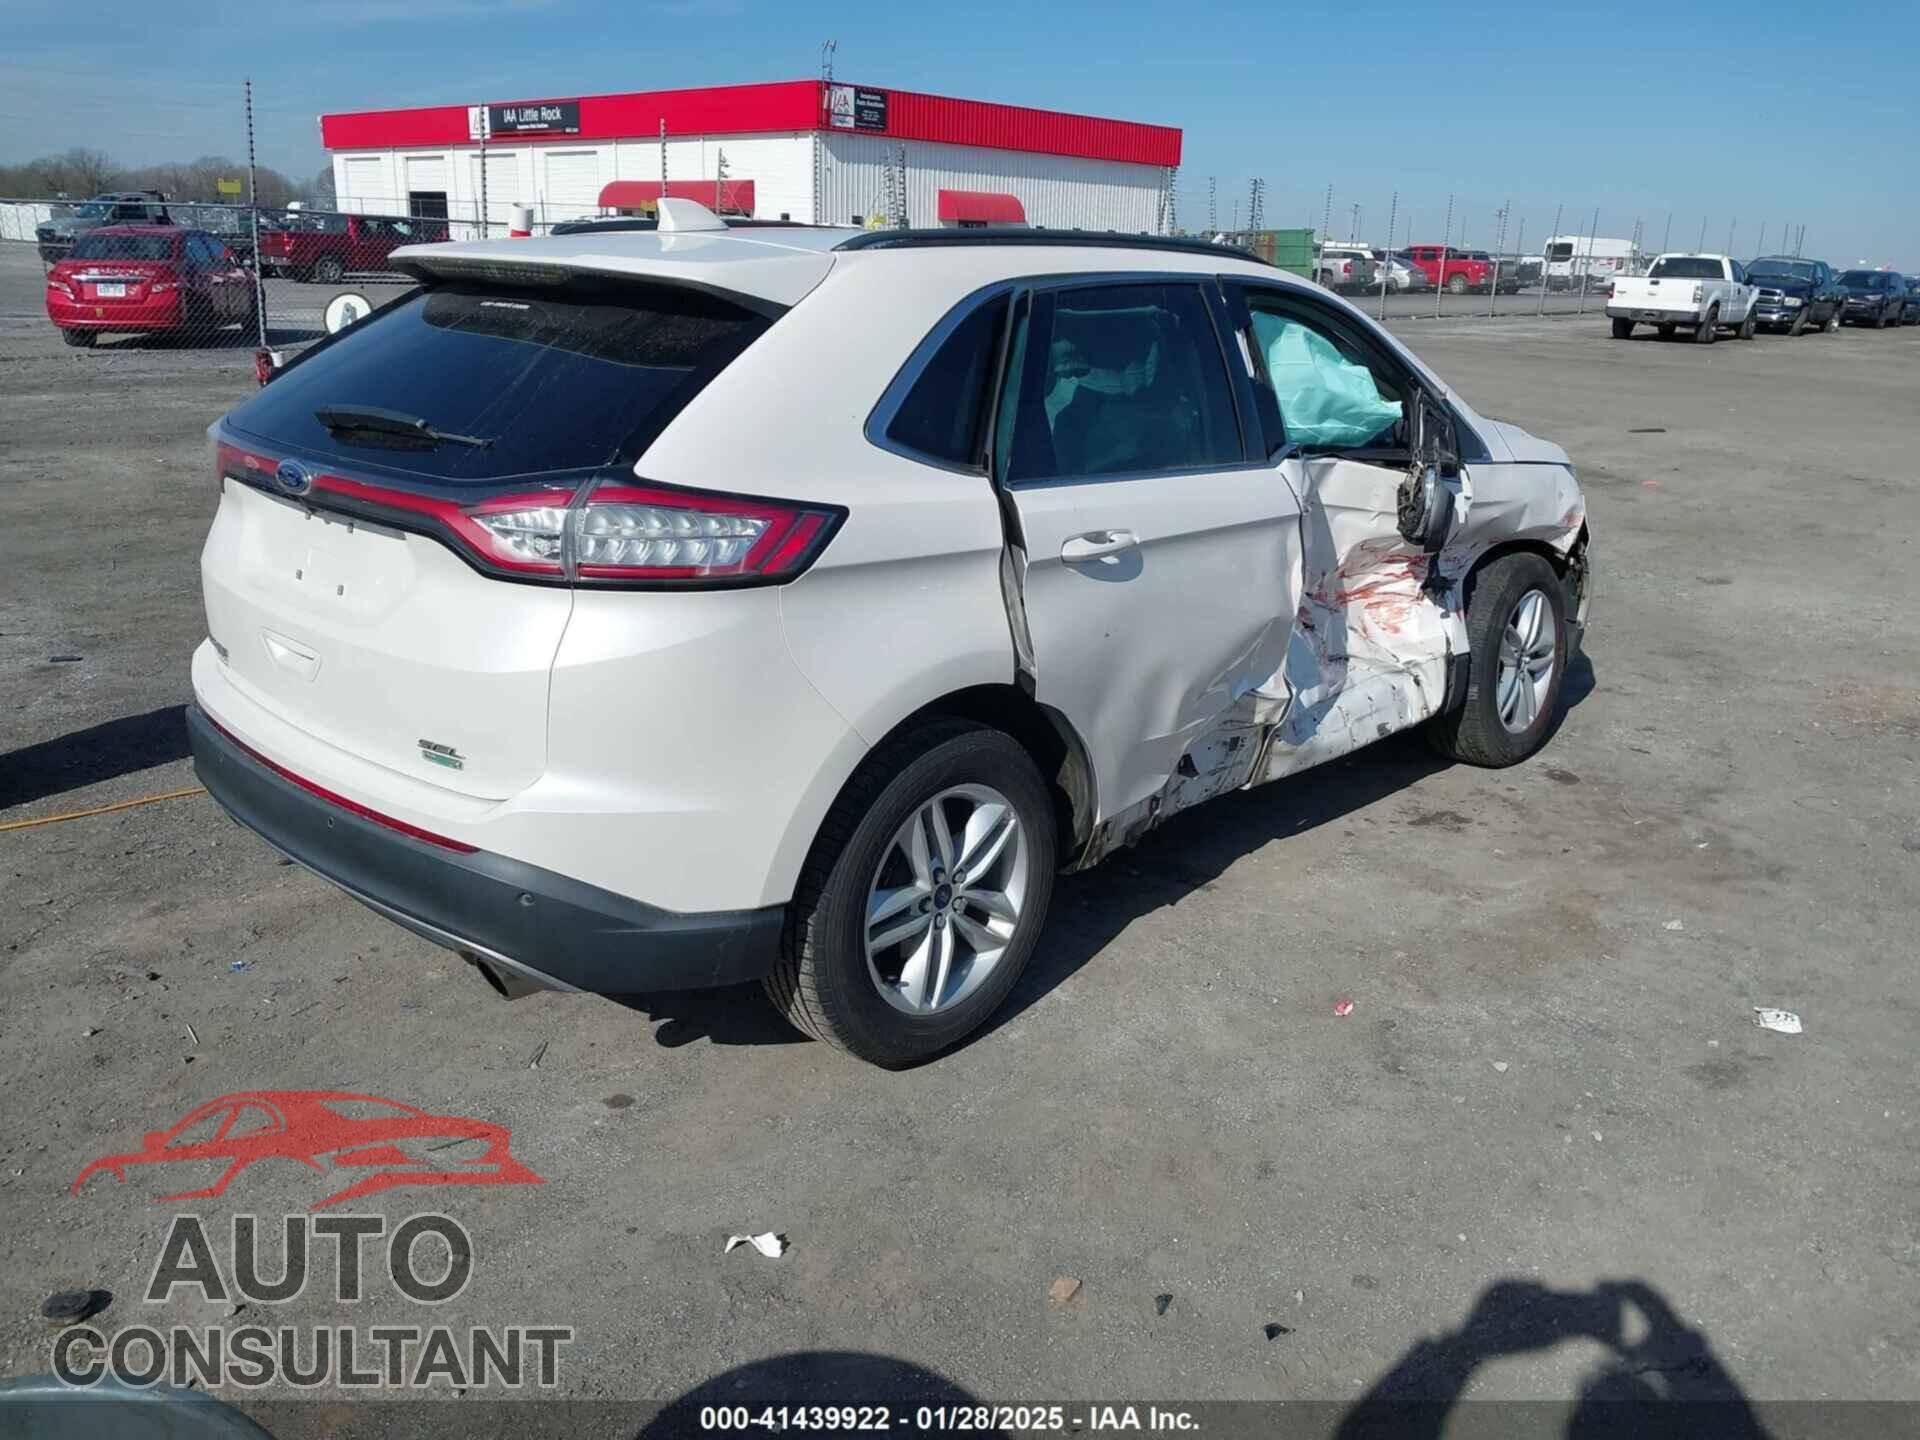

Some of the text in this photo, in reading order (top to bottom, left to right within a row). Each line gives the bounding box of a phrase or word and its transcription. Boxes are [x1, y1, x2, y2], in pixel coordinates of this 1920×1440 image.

[503, 108, 517, 123] IAA
[519, 107, 539, 122] Little
[541, 106, 562, 120] Rock
